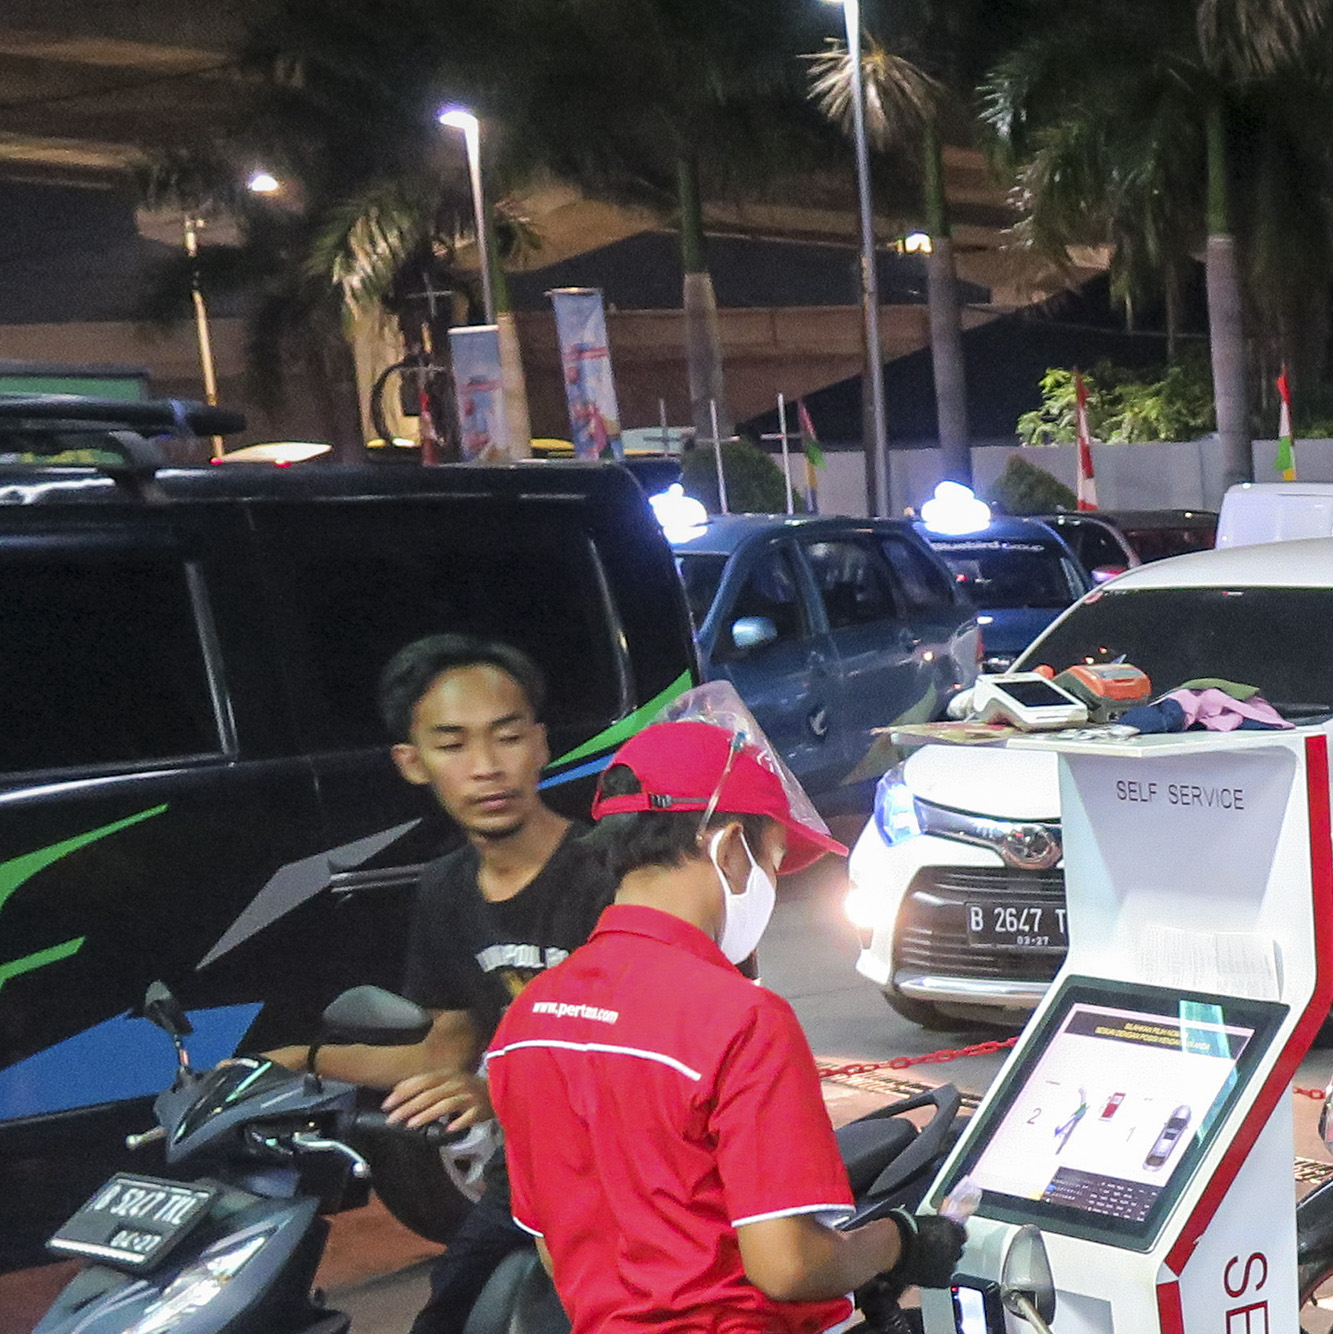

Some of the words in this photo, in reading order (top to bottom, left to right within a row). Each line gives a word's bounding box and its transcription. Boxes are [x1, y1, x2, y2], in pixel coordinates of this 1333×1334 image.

[1116, 780, 1157, 802] SELF
[1168, 784, 1245, 810] SERVICE
[970, 906, 984, 931] B
[994, 907, 1042, 932] 2647
[1026, 1107, 1042, 1125] 2
